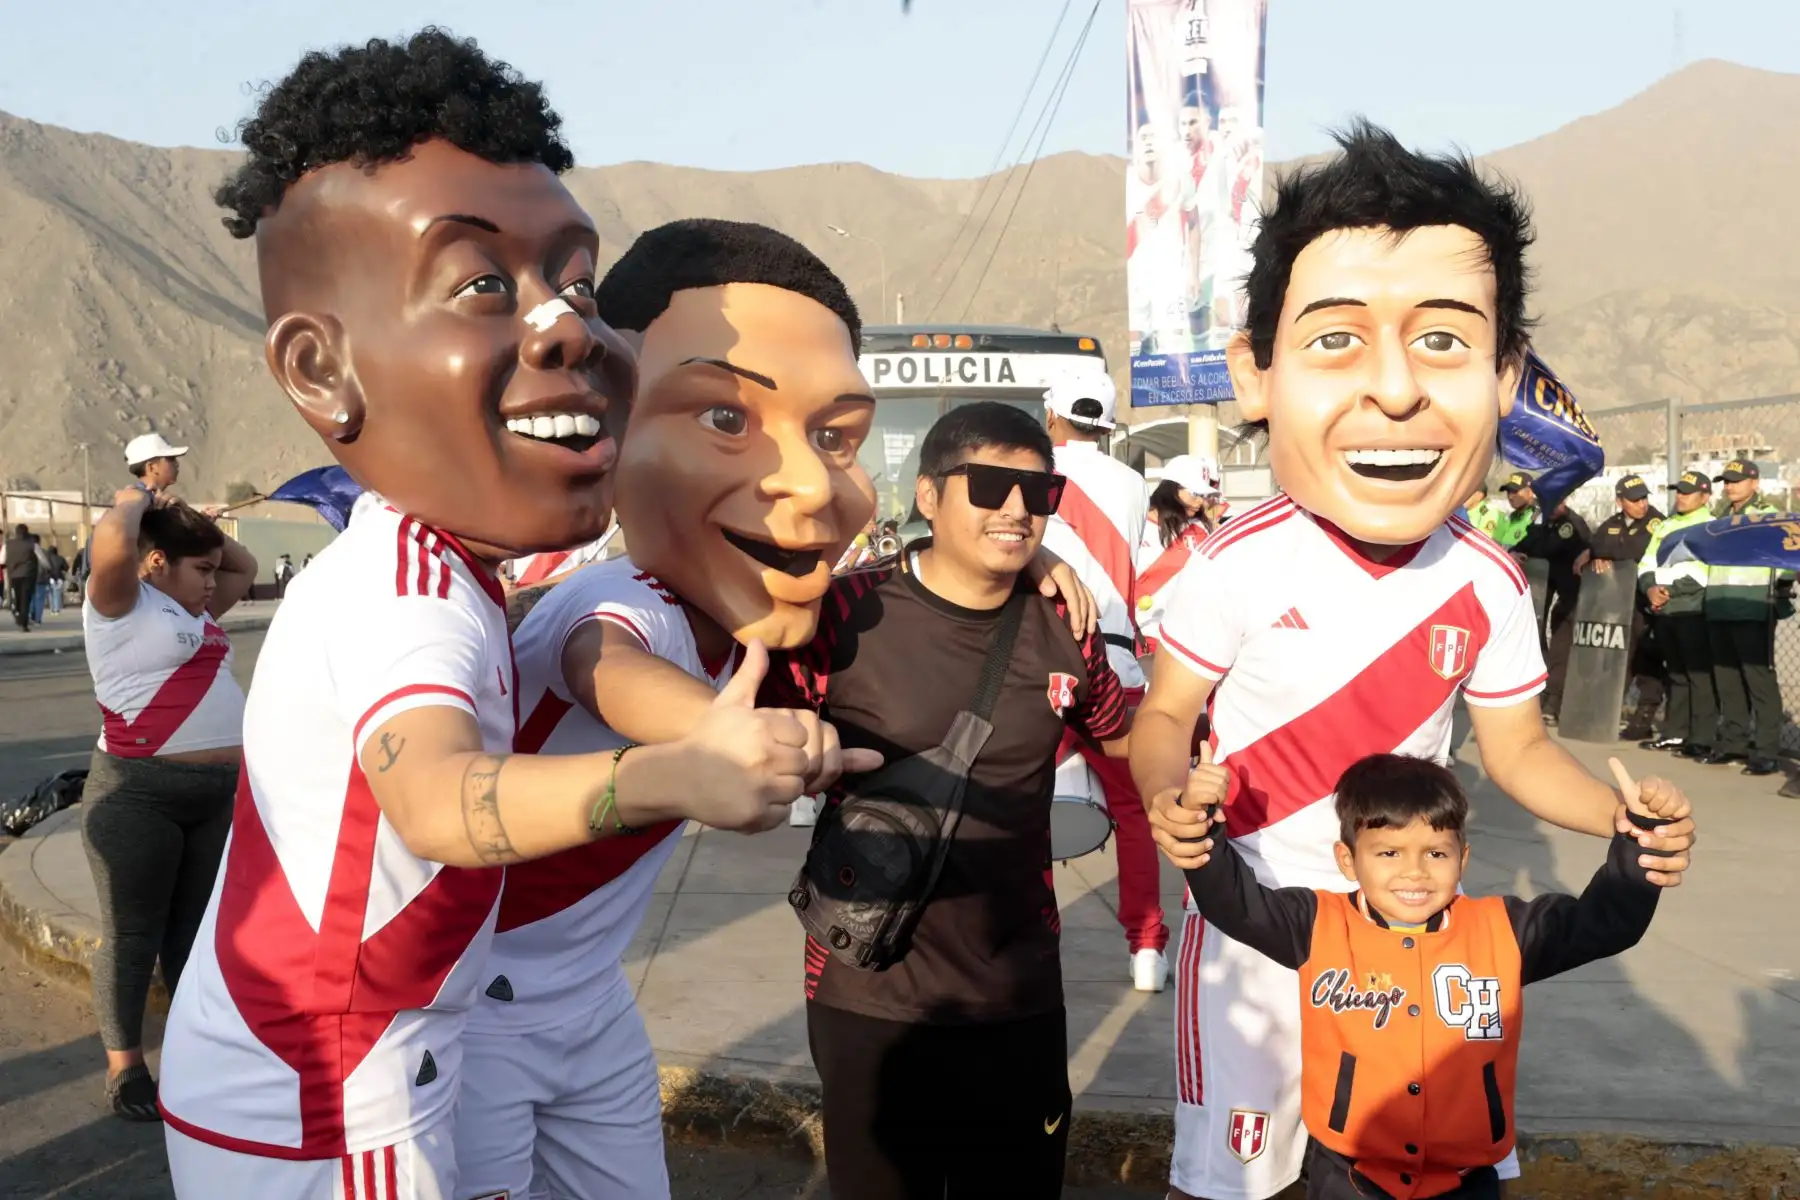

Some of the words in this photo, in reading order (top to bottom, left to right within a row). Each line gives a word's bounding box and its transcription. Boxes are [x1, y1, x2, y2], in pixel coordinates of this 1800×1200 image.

[873, 356, 1016, 384] POLICIA
[1573, 621, 1625, 650] OLICIA
[1311, 968, 1406, 1031] Chicago
